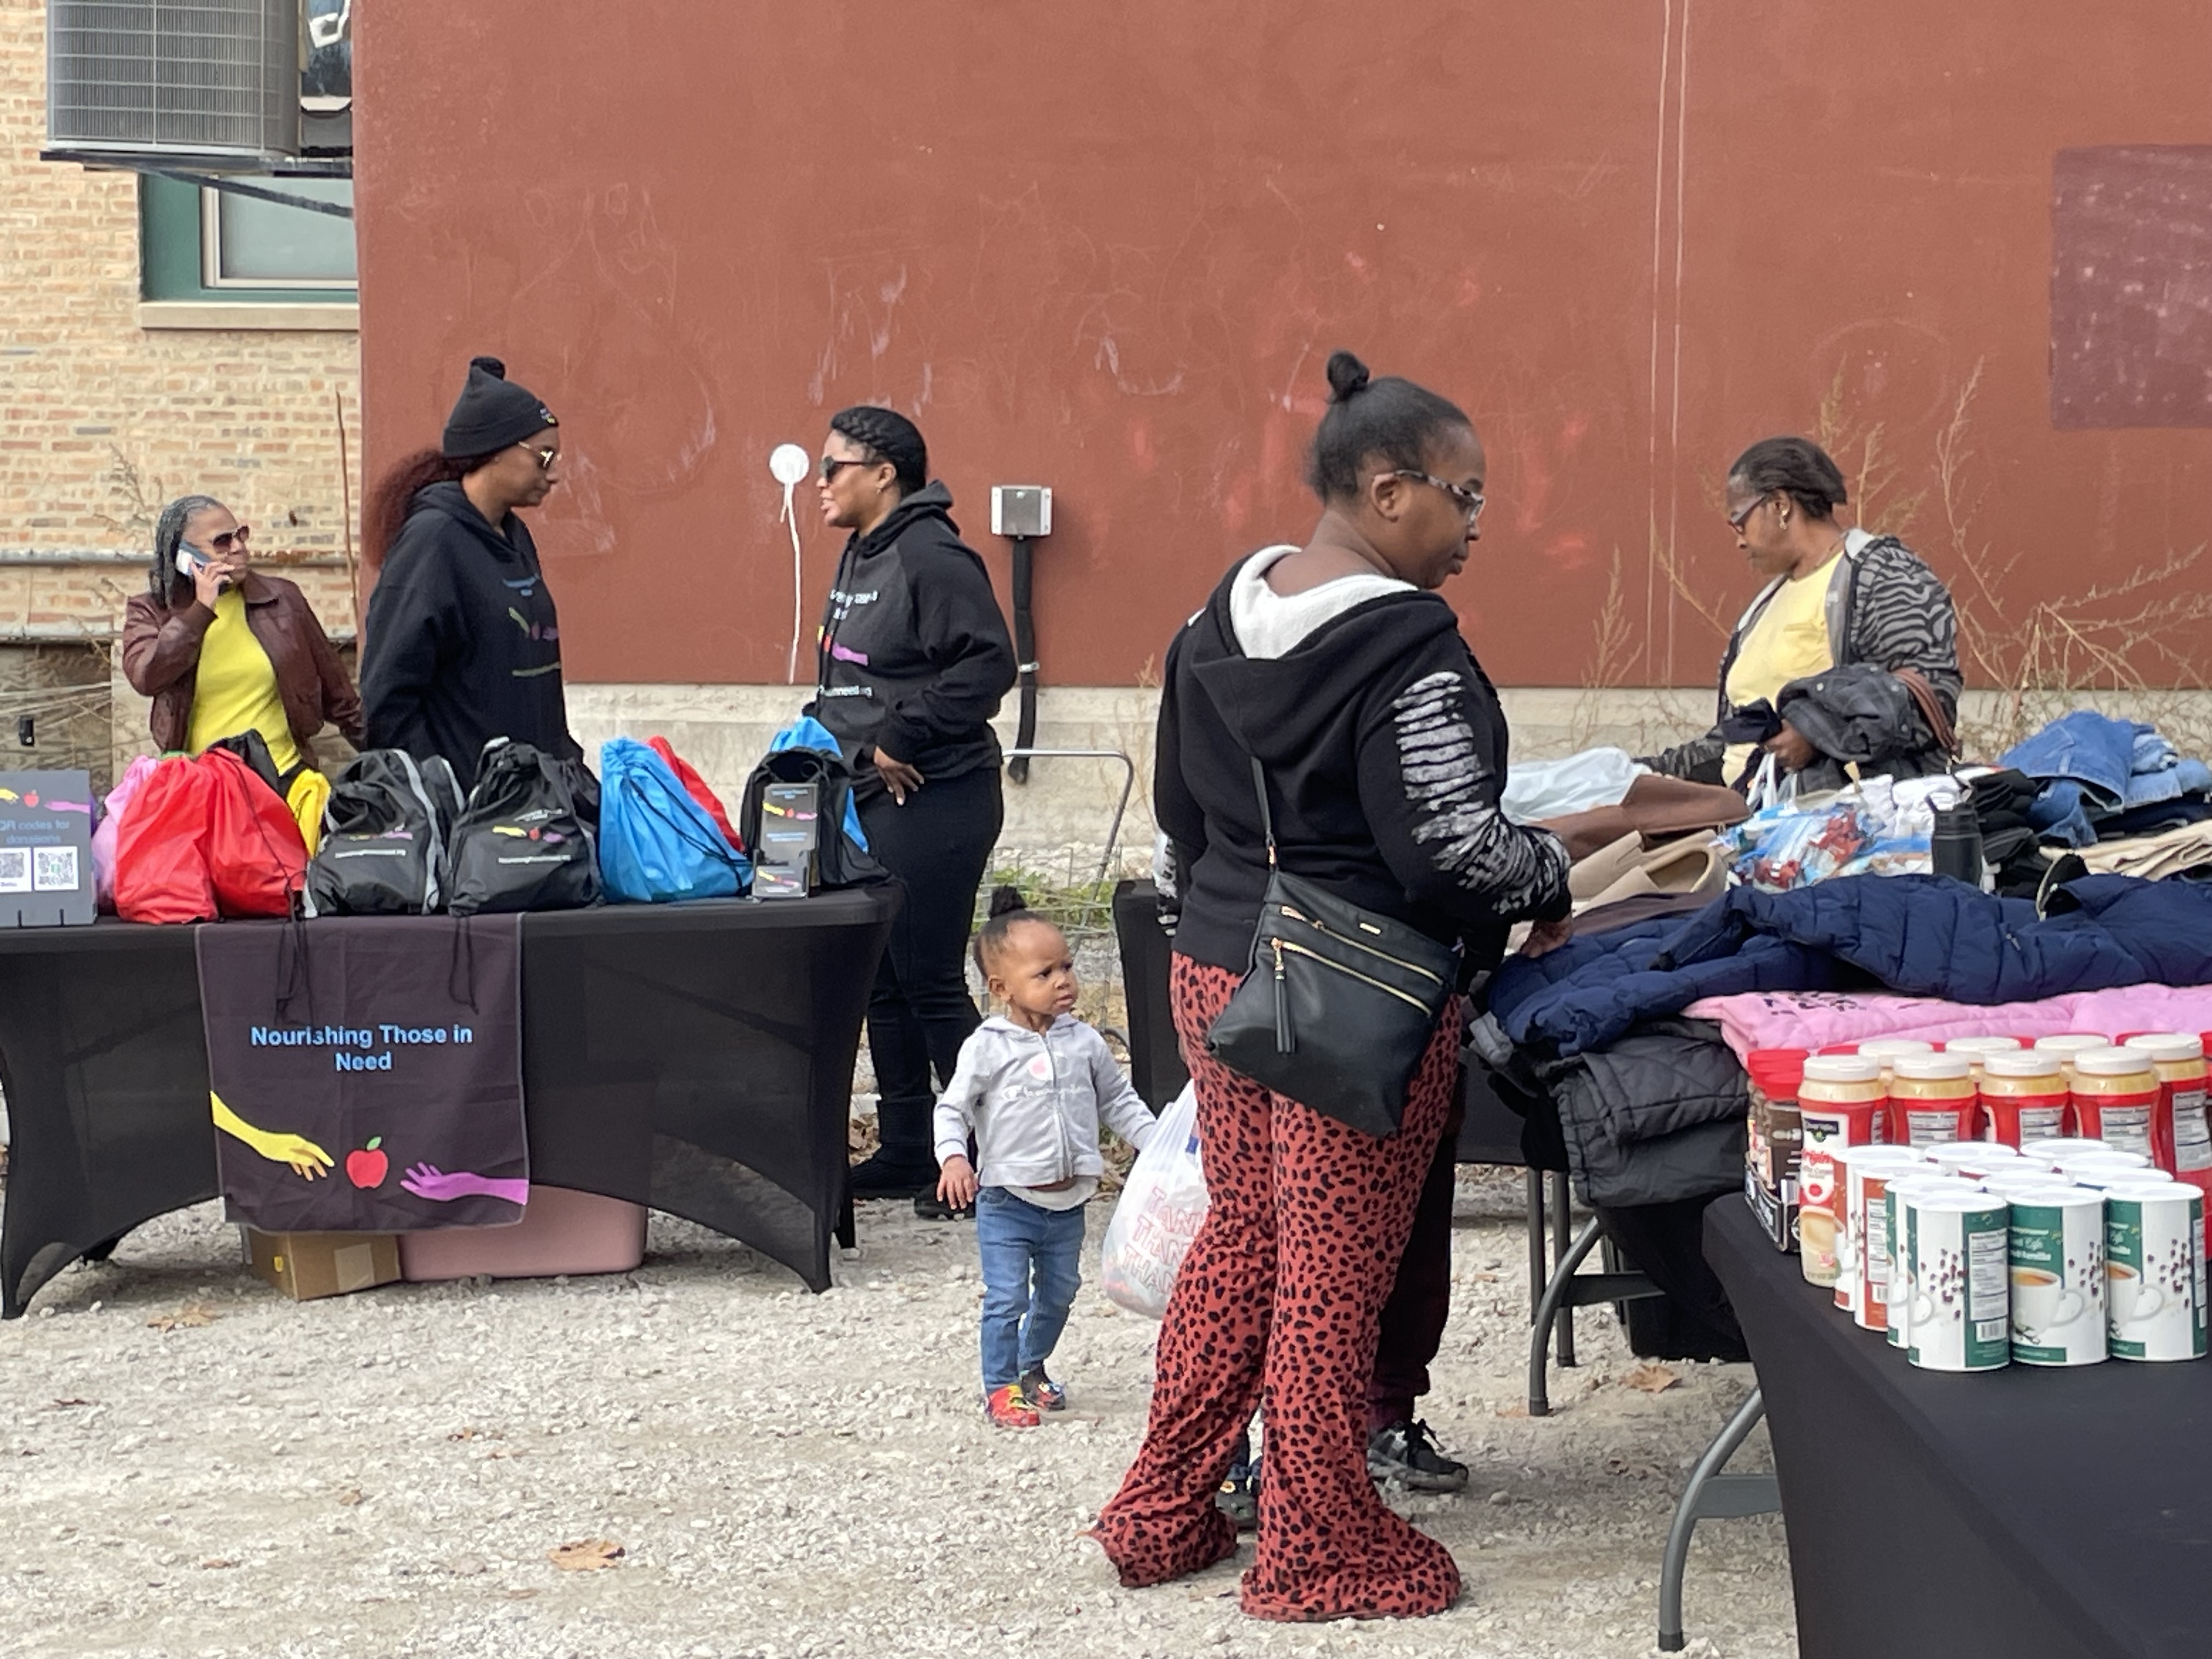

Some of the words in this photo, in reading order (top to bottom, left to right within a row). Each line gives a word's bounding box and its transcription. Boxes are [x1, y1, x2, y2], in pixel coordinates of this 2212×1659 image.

[19, 821, 53, 830] codes
[250, 1025, 373, 1049] Nourishing
[379, 1024, 447, 1043] Those
[453, 1024, 473, 1043] in
[335, 1051, 393, 1071] Need
